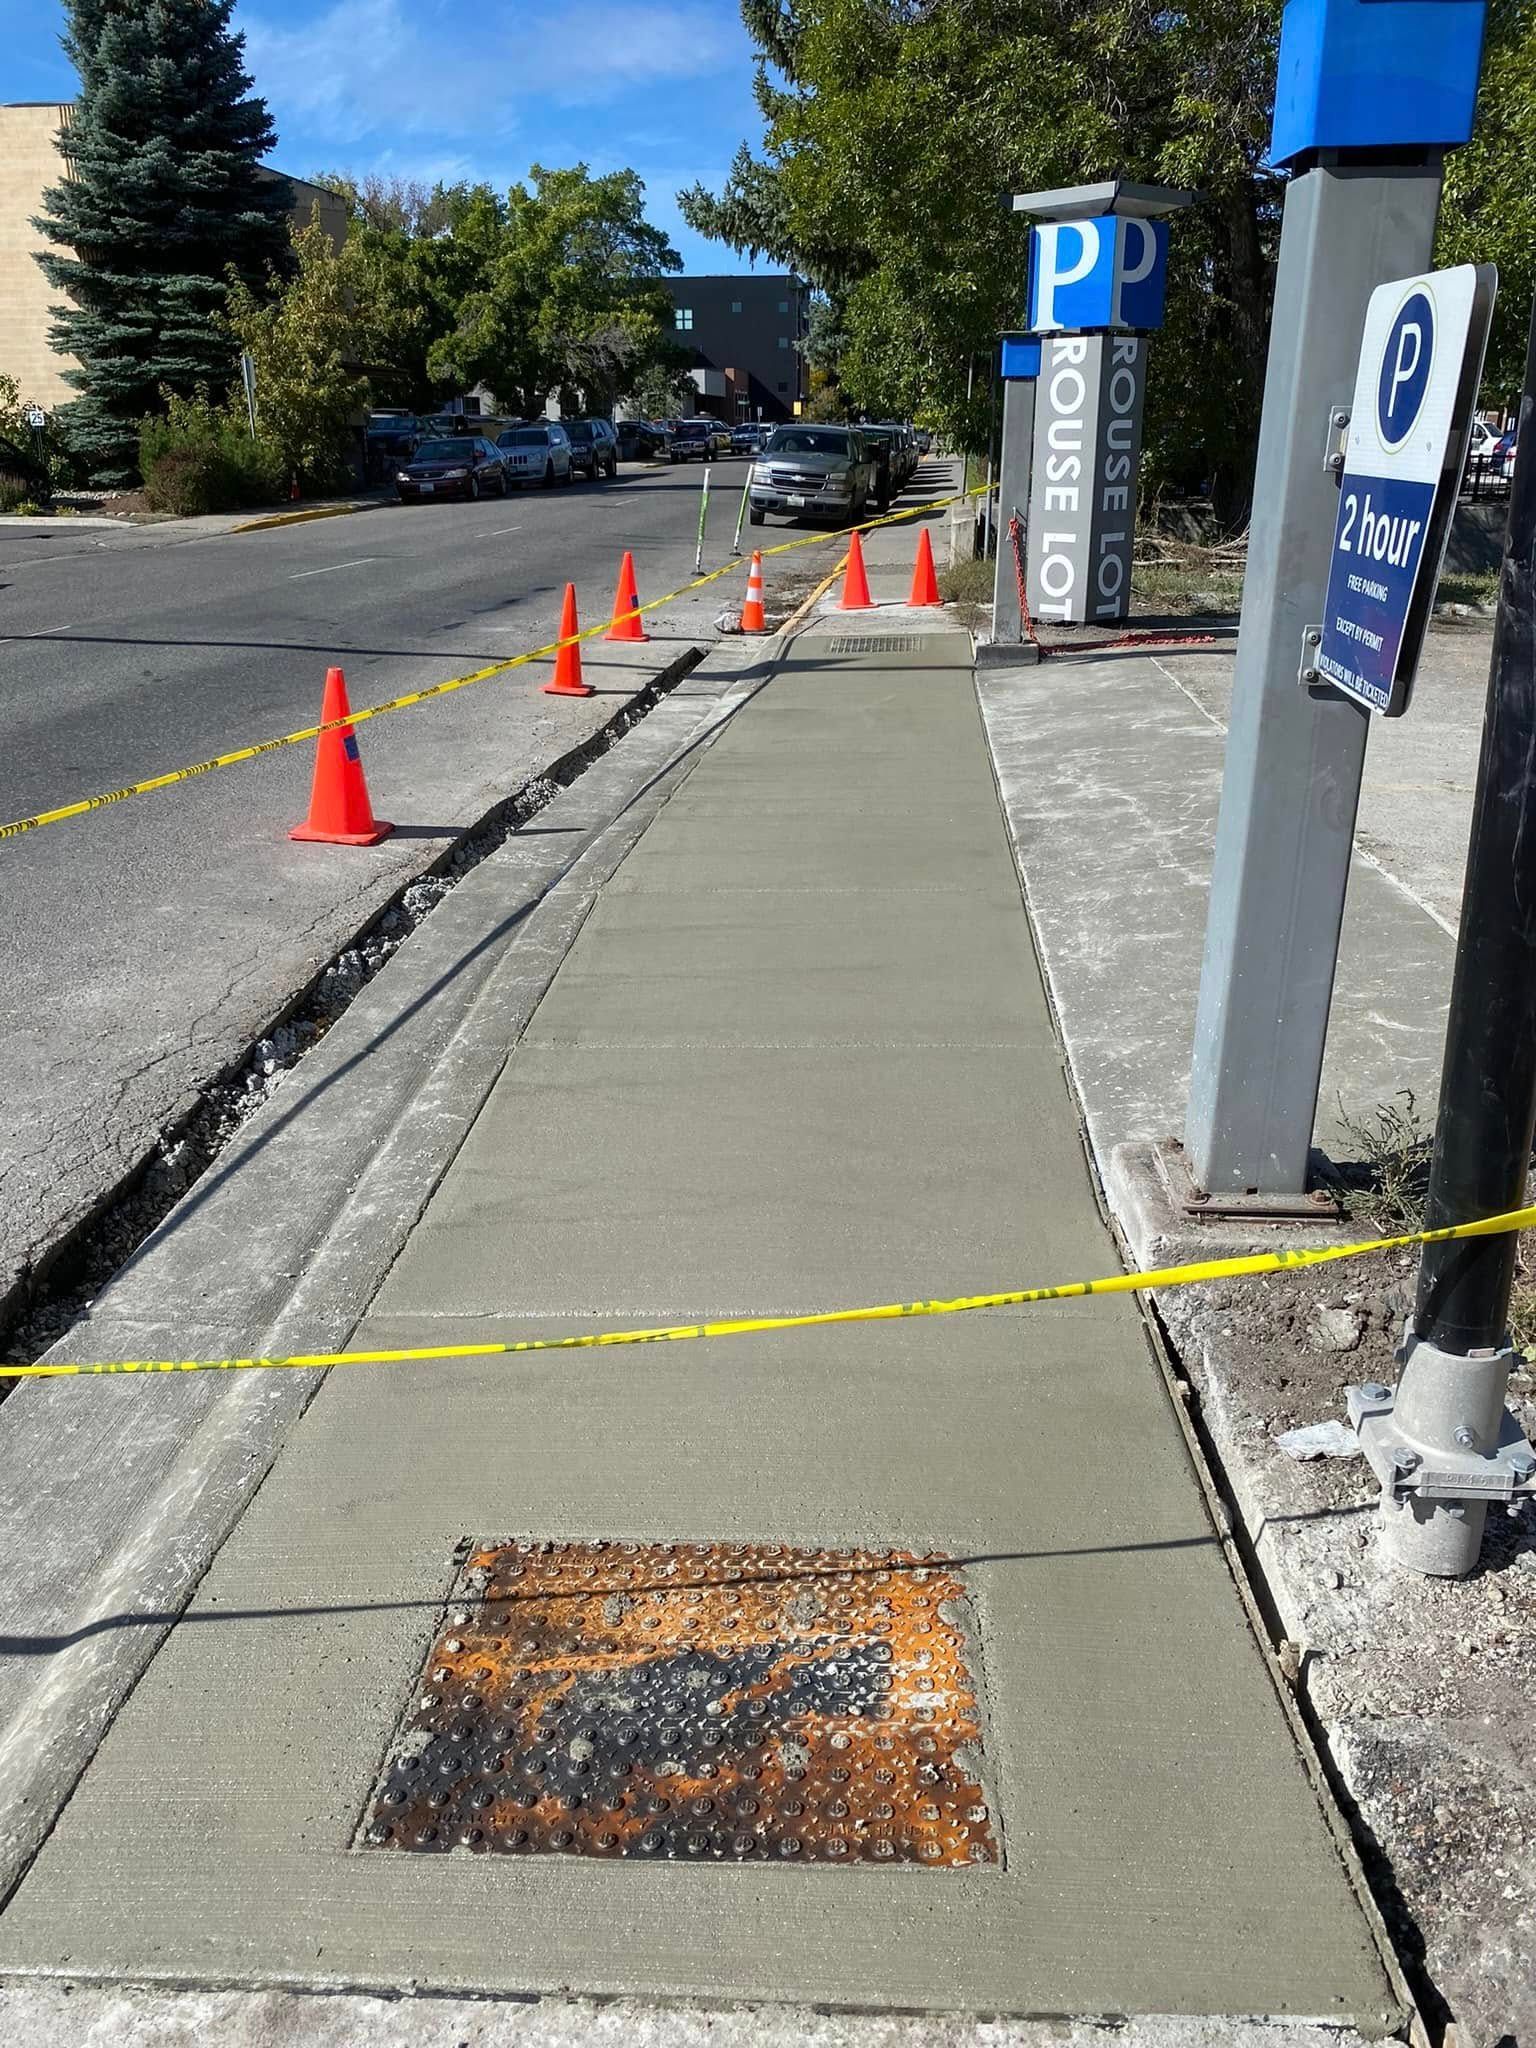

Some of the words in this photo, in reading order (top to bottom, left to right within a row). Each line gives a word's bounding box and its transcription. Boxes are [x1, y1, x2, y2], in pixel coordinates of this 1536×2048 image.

[1031, 220, 1100, 332] P
[1110, 215, 1157, 327] P
[1387, 322, 1422, 418] P
[31, 412, 43, 424] 25
[1044, 336, 1089, 512] ROUSE
[1102, 336, 1139, 512] ROUSE
[1095, 531, 1126, 618] LOT
[1339, 493, 1358, 551] 2
[1357, 493, 1421, 568] hour
[1039, 532, 1077, 621] LOT
[1347, 573, 1363, 593] FREE
[1361, 578, 1389, 602] PARKING
[1336, 616, 1356, 638] EXCEPT
[1354, 625, 1364, 642] BY
[1362, 629, 1384, 652] PERMIT
